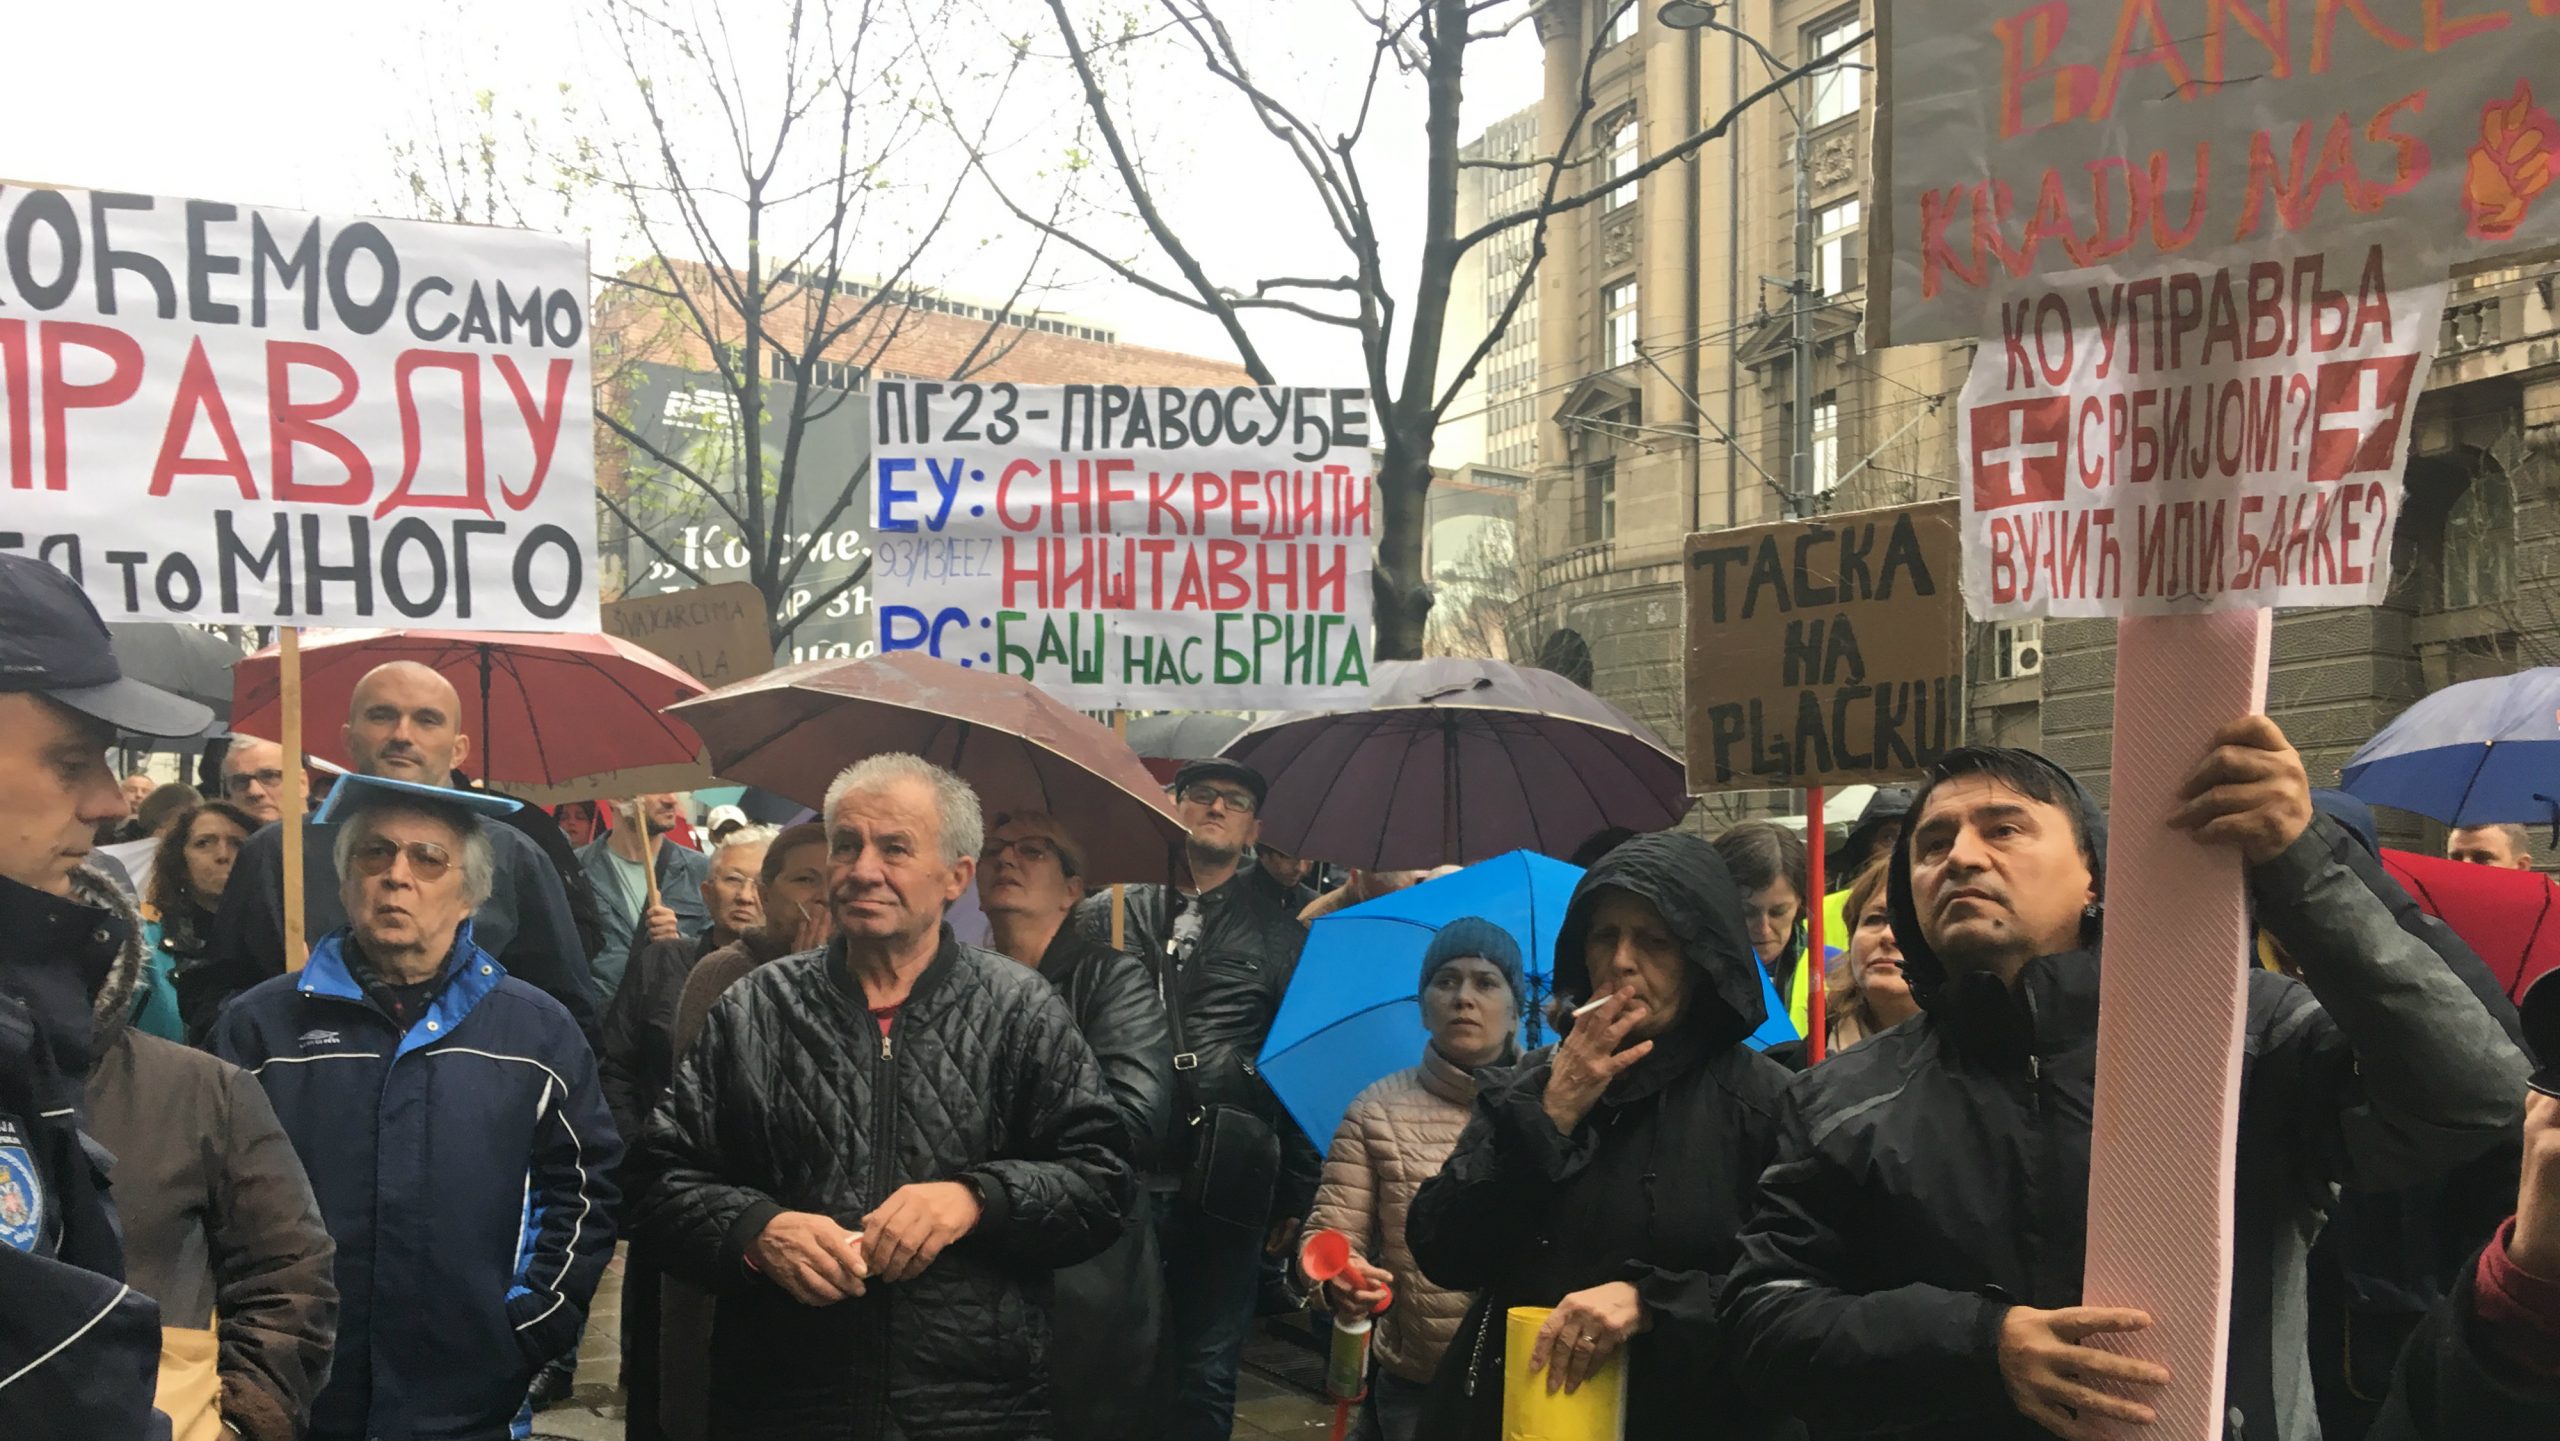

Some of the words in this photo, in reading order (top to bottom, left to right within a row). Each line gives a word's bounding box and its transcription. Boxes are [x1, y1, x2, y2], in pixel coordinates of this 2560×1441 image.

[1920, 142, 2211, 300] KRADU
[2236, 89, 2431, 243] NAS
[0, 185, 400, 335] ОЋЕМО
[406, 276, 582, 348] САМО
[2002, 293, 2074, 391] КО
[2089, 243, 2392, 380] УПРАВЉА
[2077, 373, 2311, 490] СРБИЈОМ?
[878, 457, 985, 533] ЕУ:
[1147, 465, 1371, 541] КРЕДИТИ
[2137, 498, 2225, 597] ИЛИ
[2231, 481, 2388, 592] БАНКЕ?
[214, 509, 582, 620] МНОГО
[1001, 536, 1346, 613] НИШТАВНИ
[1691, 513, 1936, 623] TAČKA
[996, 611, 1103, 683] БАШ
[1123, 636, 1203, 685] НАС
[1214, 613, 1369, 687] БРИГА
[1783, 612, 1866, 687] NA
